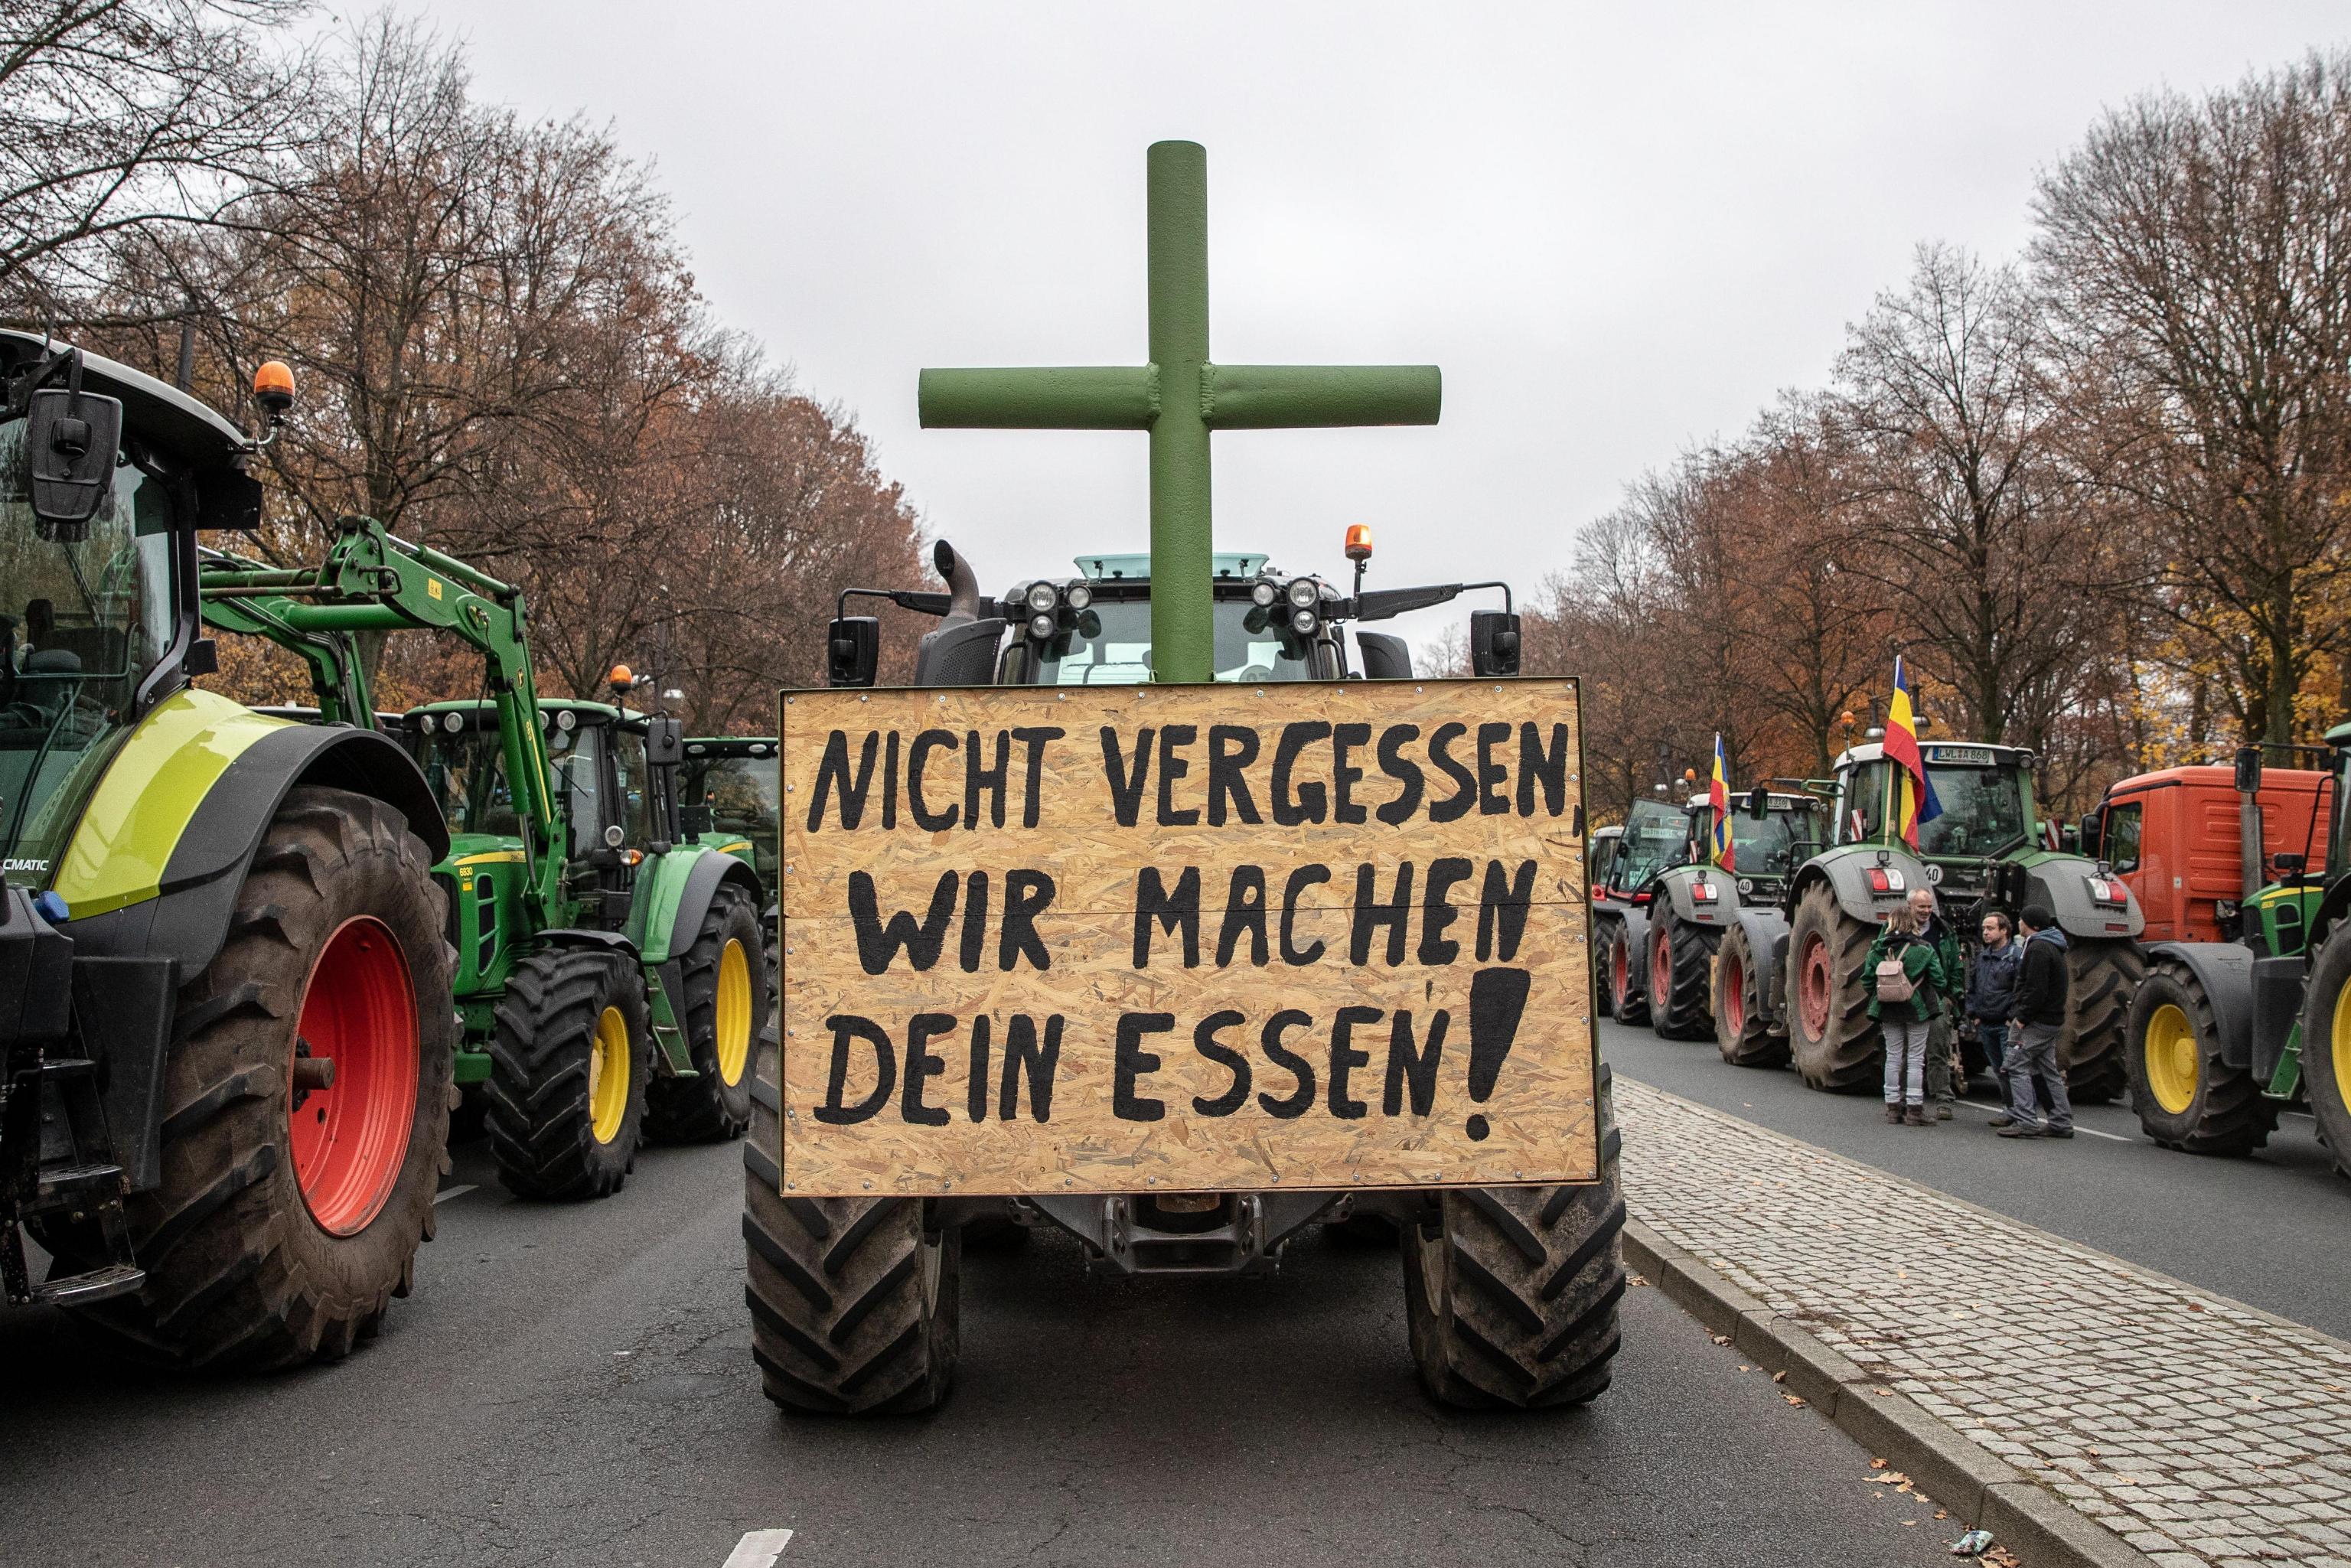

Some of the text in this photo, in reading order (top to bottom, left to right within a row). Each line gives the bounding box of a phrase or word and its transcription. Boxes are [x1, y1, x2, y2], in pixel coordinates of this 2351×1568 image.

[1939, 749, 1988, 760] LWL A 868
[807, 727, 1065, 833] NICHT
[2, 859, 49, 871] CMATIC
[1925, 868, 1939, 881] 40
[1740, 881, 1750, 891] 40
[848, 857, 1537, 975] WIR MACHEN
[814, 967, 1531, 1142] DEIN ESSEN!
